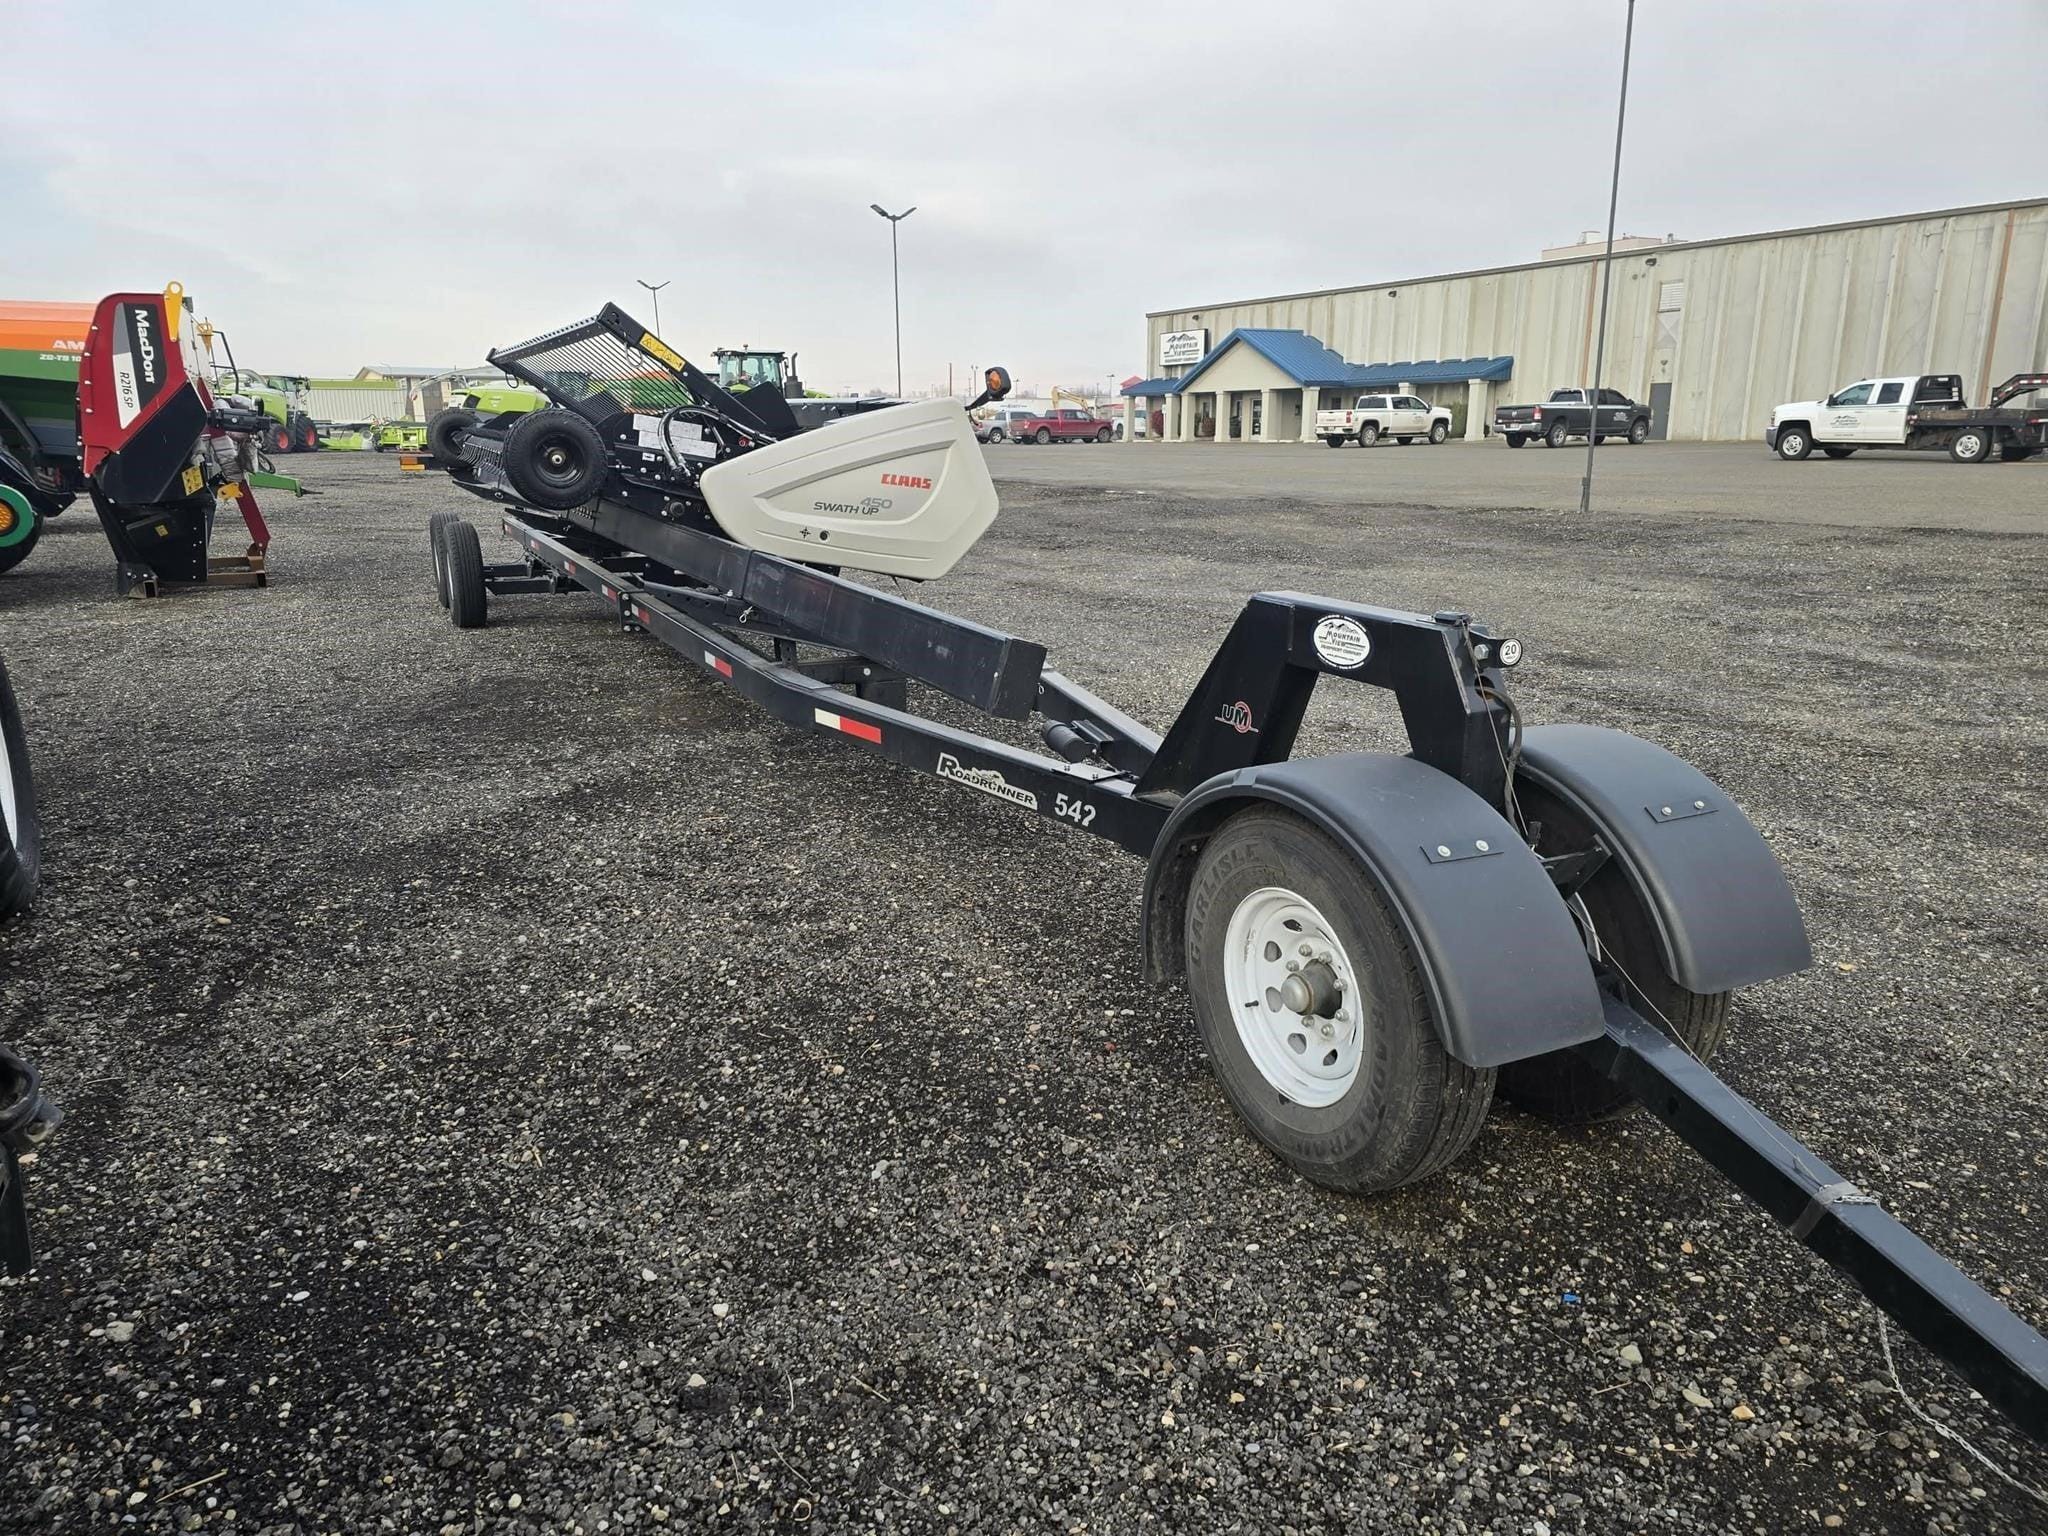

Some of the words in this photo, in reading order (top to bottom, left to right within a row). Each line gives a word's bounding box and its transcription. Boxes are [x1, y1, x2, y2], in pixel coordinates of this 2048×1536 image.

[134, 309, 155, 383] MacDon
[120, 371, 133, 395] R216
[124, 396, 133, 408] SP
[881, 473, 931, 489] CLAAS
[813, 501, 859, 514] SWATH
[861, 506, 879, 515] UP
[860, 497, 893, 509] 450
[1326, 630, 1361, 643] MOUNTAIN
[1505, 644, 1517, 656] 20
[1222, 704, 1250, 727] UM
[937, 753, 1036, 808] ROADRUNNER
[1054, 792, 1096, 827] 542
[1190, 843, 1261, 965] CARLISLE
